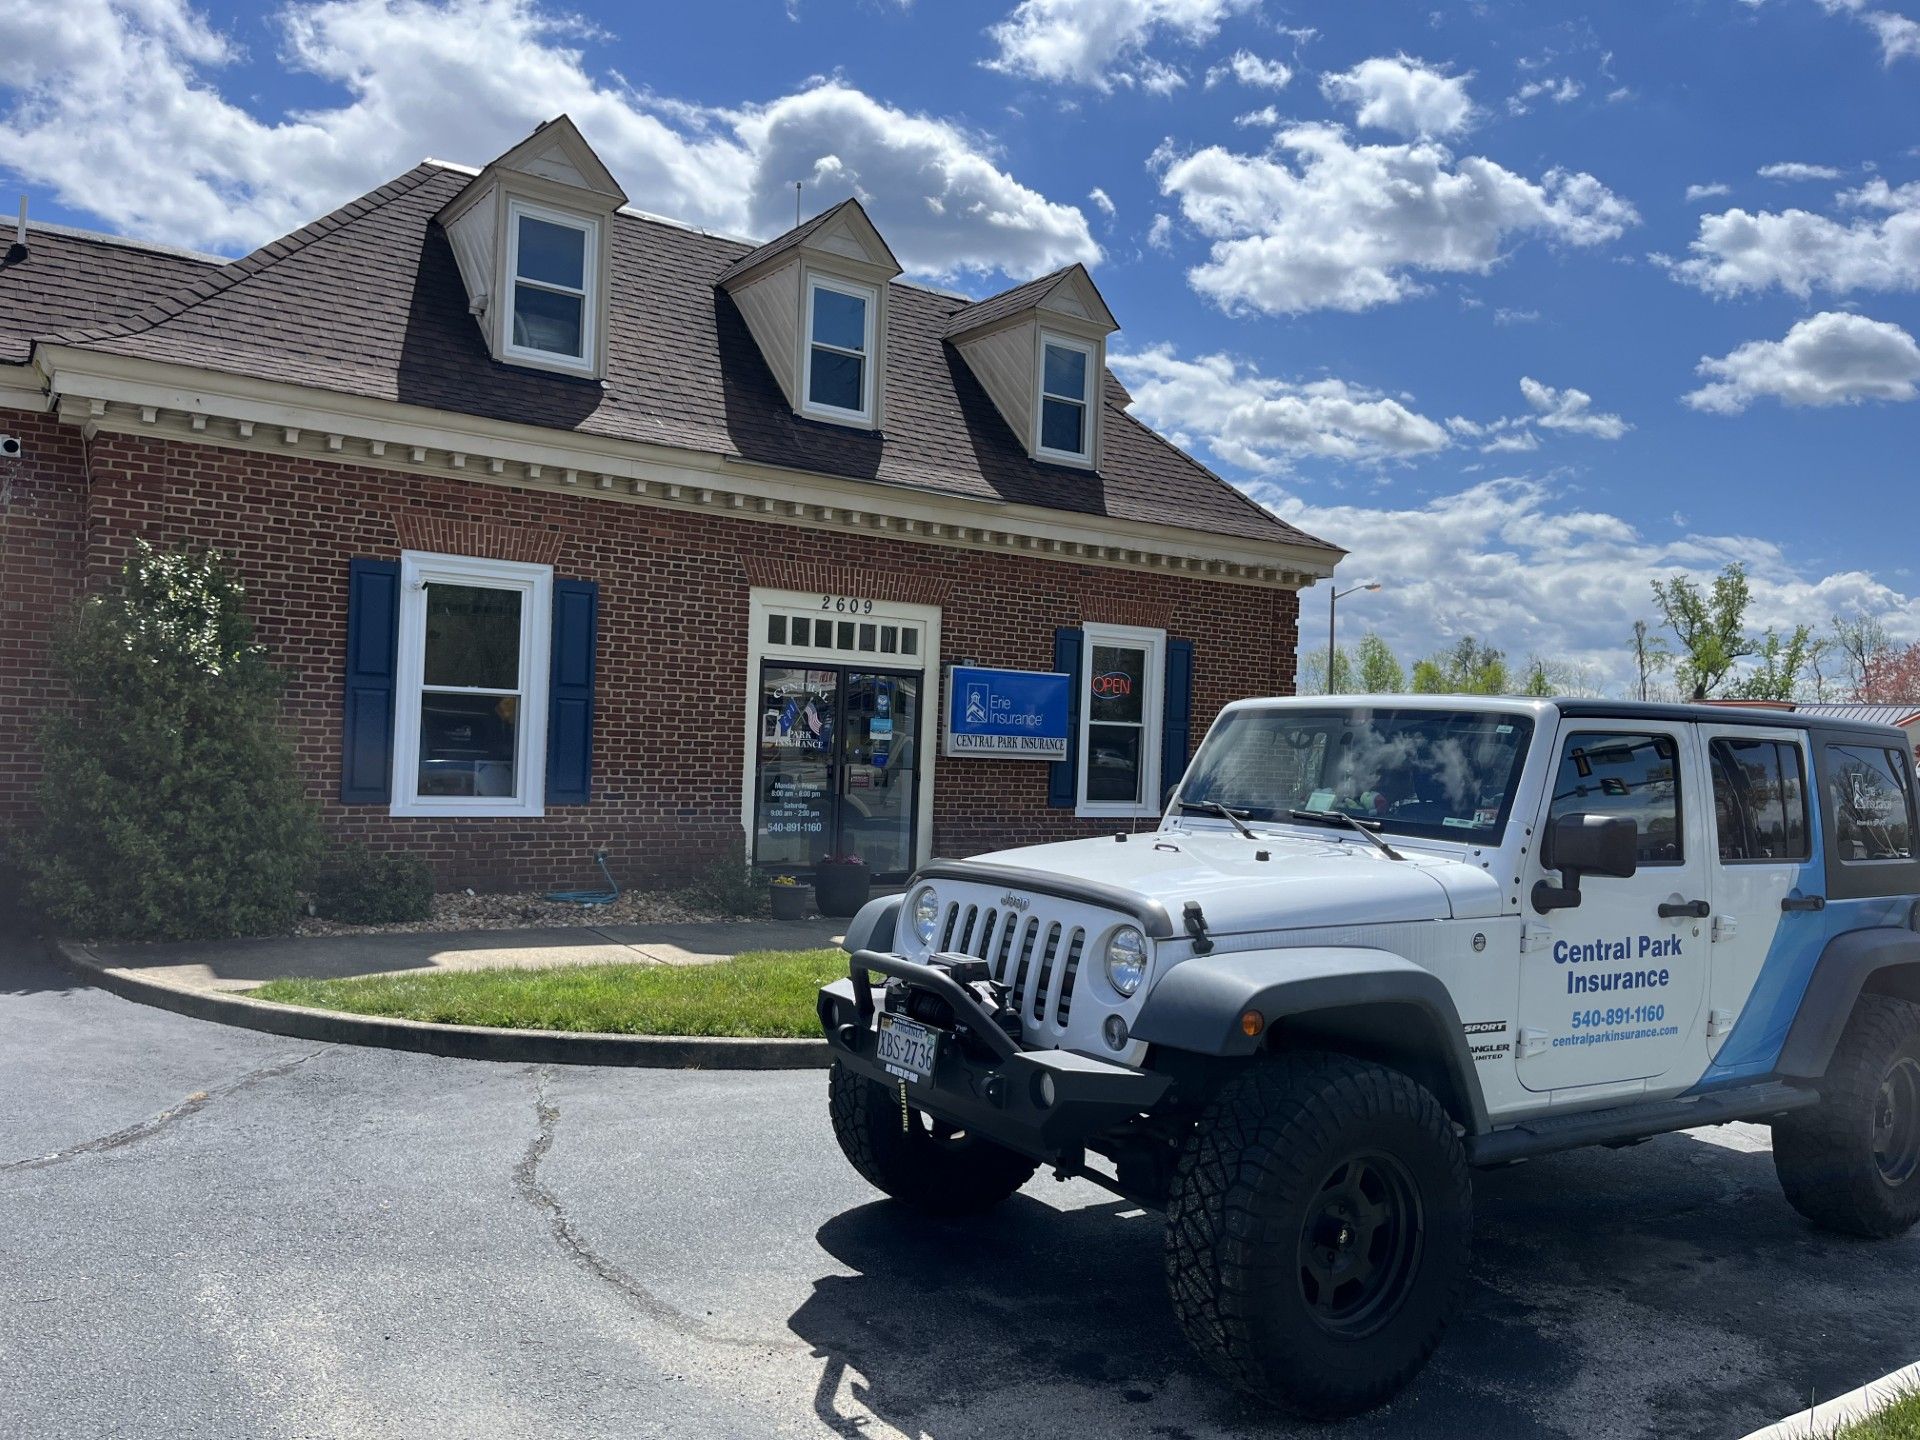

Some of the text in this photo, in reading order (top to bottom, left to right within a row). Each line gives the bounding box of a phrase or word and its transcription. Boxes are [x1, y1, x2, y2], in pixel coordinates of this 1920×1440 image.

[822, 595, 873, 614] 2609
[773, 682, 829, 704] CENTRAL
[1092, 676, 1132, 695] OPEN
[990, 694, 1012, 710] Erie
[989, 710, 1043, 726] Insurance
[789, 730, 812, 739] PARK
[775, 740, 824, 749] INSURANCE
[956, 735, 1065, 751] CENTRAL PARK INSURANCE
[774, 782, 796, 790] Monday
[801, 782, 818, 791] Friday
[811, 791, 821, 799] pm
[783, 802, 808, 810] Saturday
[767, 822, 822, 833] 540-891-1160
[1000, 891, 1030, 912] Jeep
[1553, 933, 1683, 964] Central Park
[1567, 968, 1670, 994] Insurance
[1571, 1004, 1665, 1029] 540-891-1160
[1463, 1022, 1505, 1033] SPORT
[1552, 1026, 1678, 1047] centralparkinsurance.com
[878, 1028, 933, 1070] XBS-2736
[1470, 1044, 1510, 1053] ANGLER
[1475, 1053, 1503, 1061] IMITED
